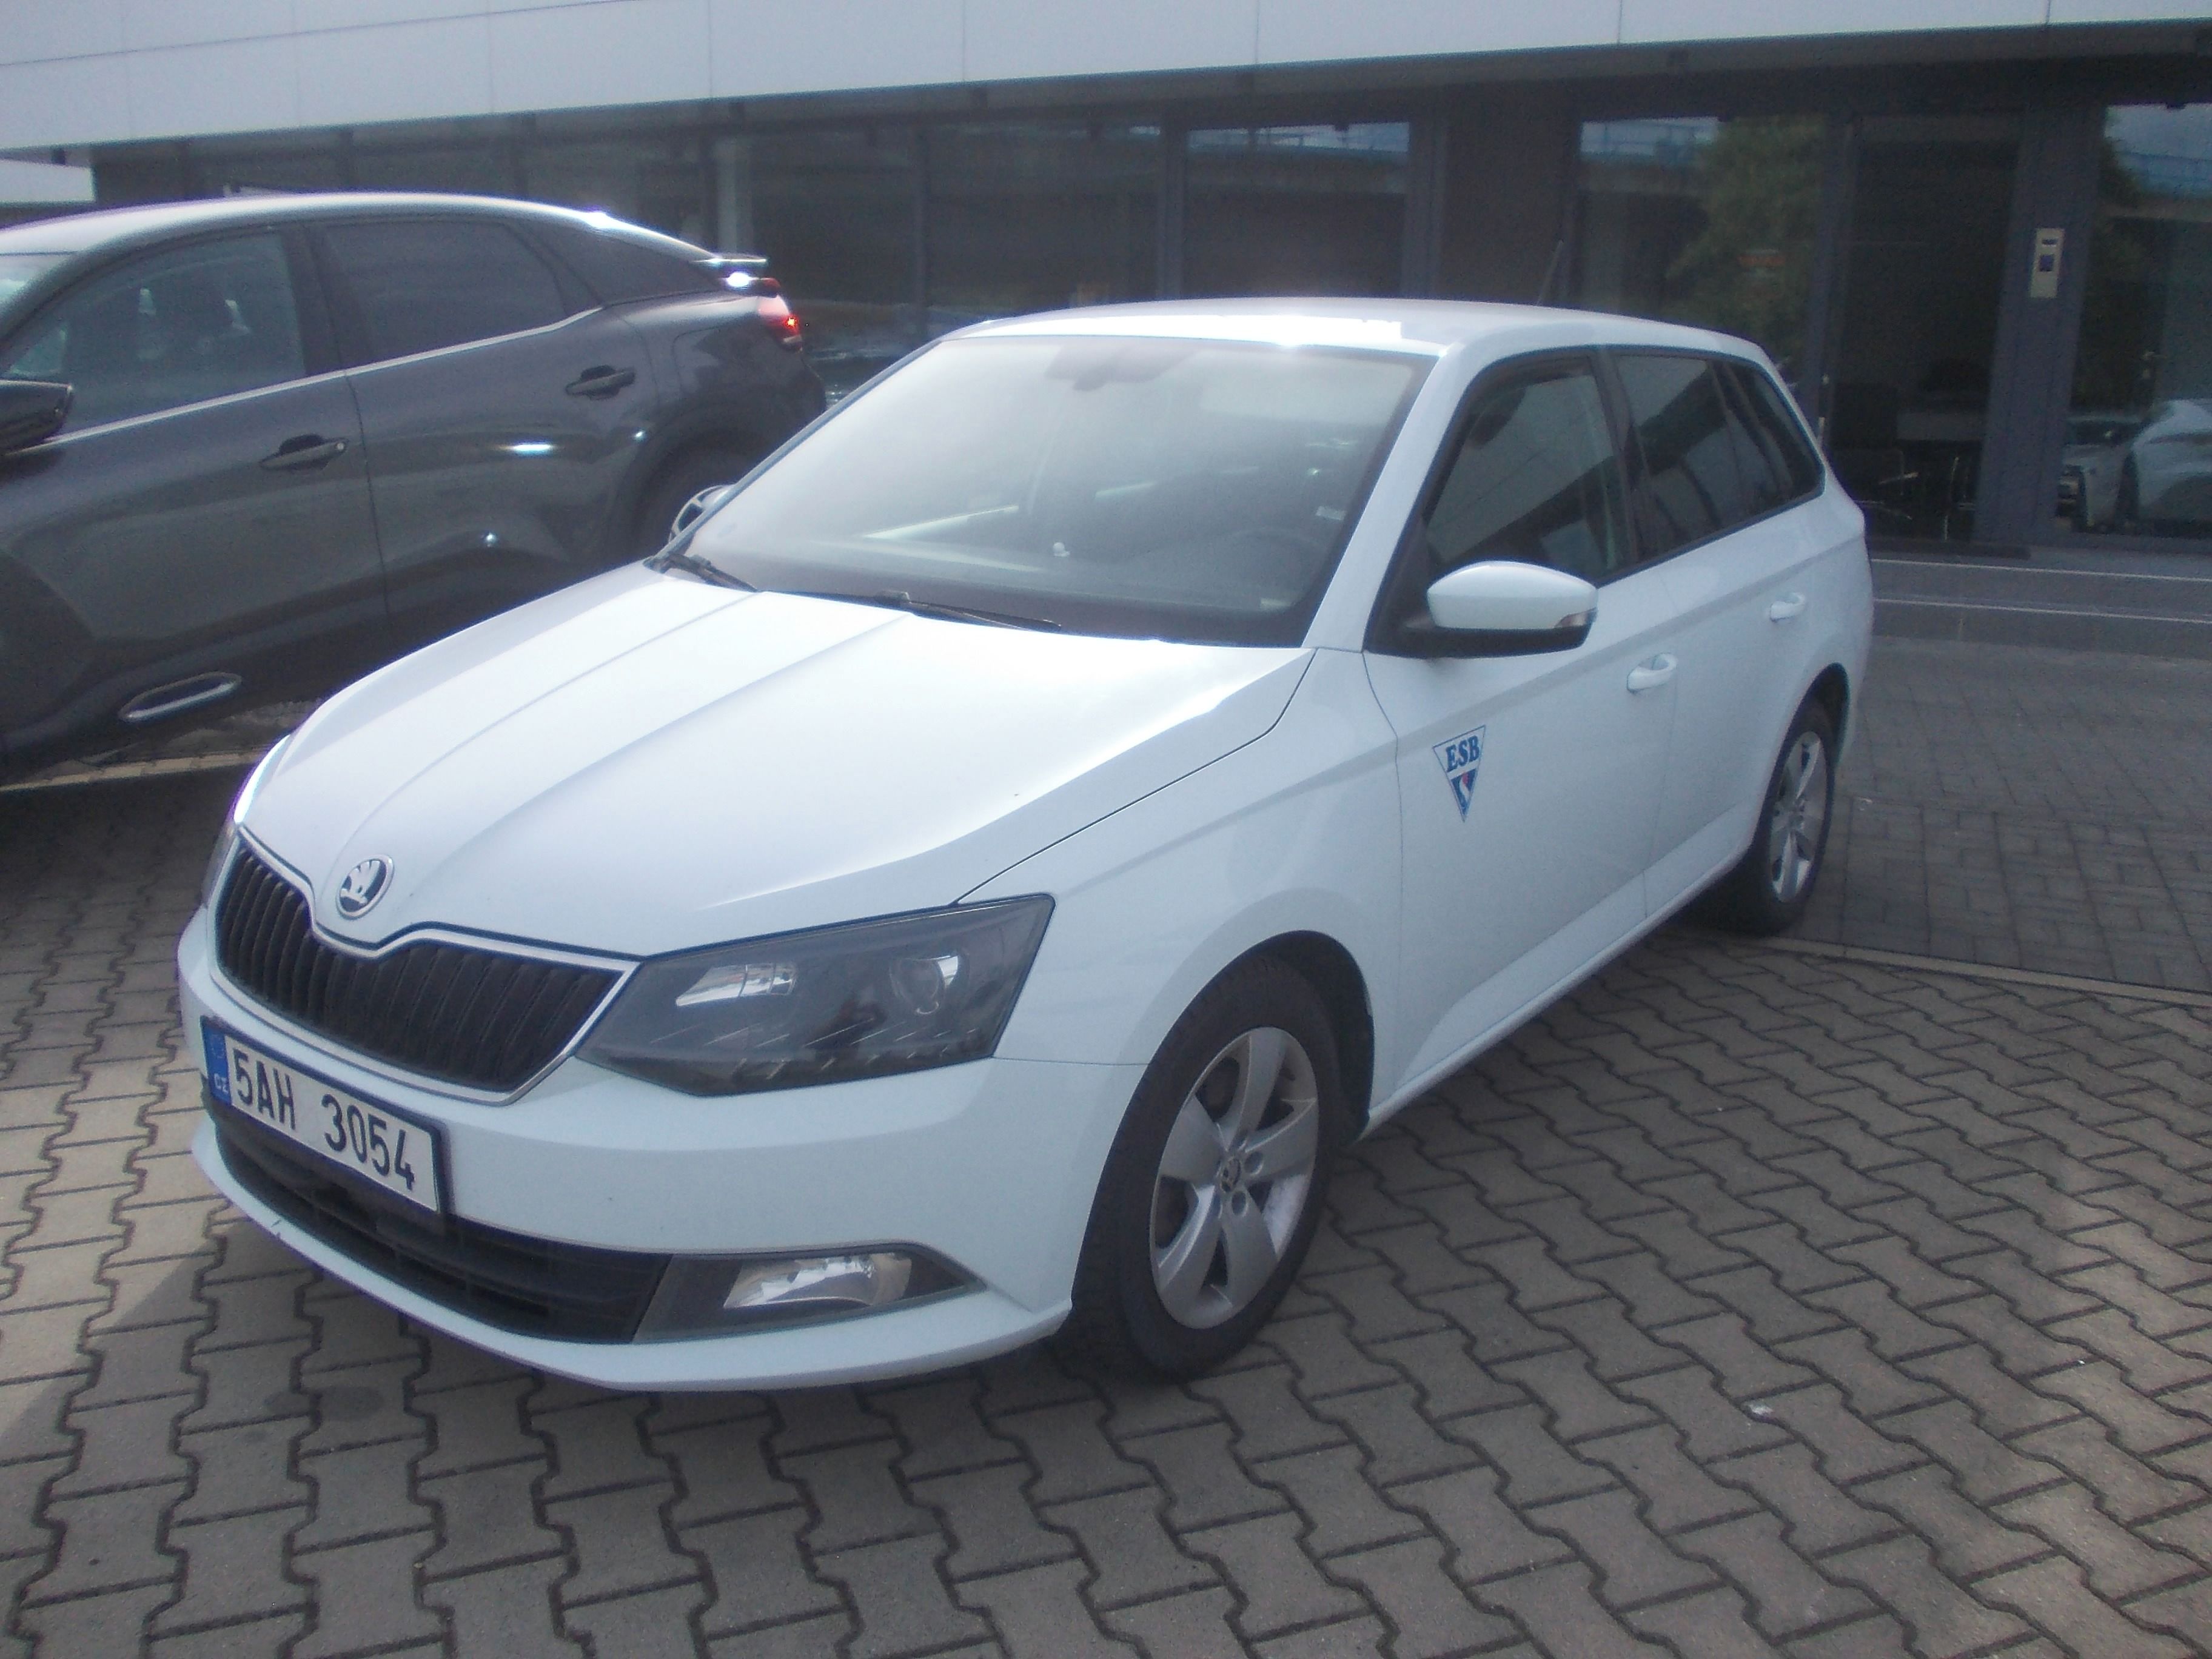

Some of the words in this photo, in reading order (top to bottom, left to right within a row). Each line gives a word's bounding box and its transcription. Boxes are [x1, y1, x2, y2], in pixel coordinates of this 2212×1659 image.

[1446, 735, 1480, 773] ESB
[233, 1048, 296, 1130] 5AH
[321, 1094, 415, 1191] 3054
